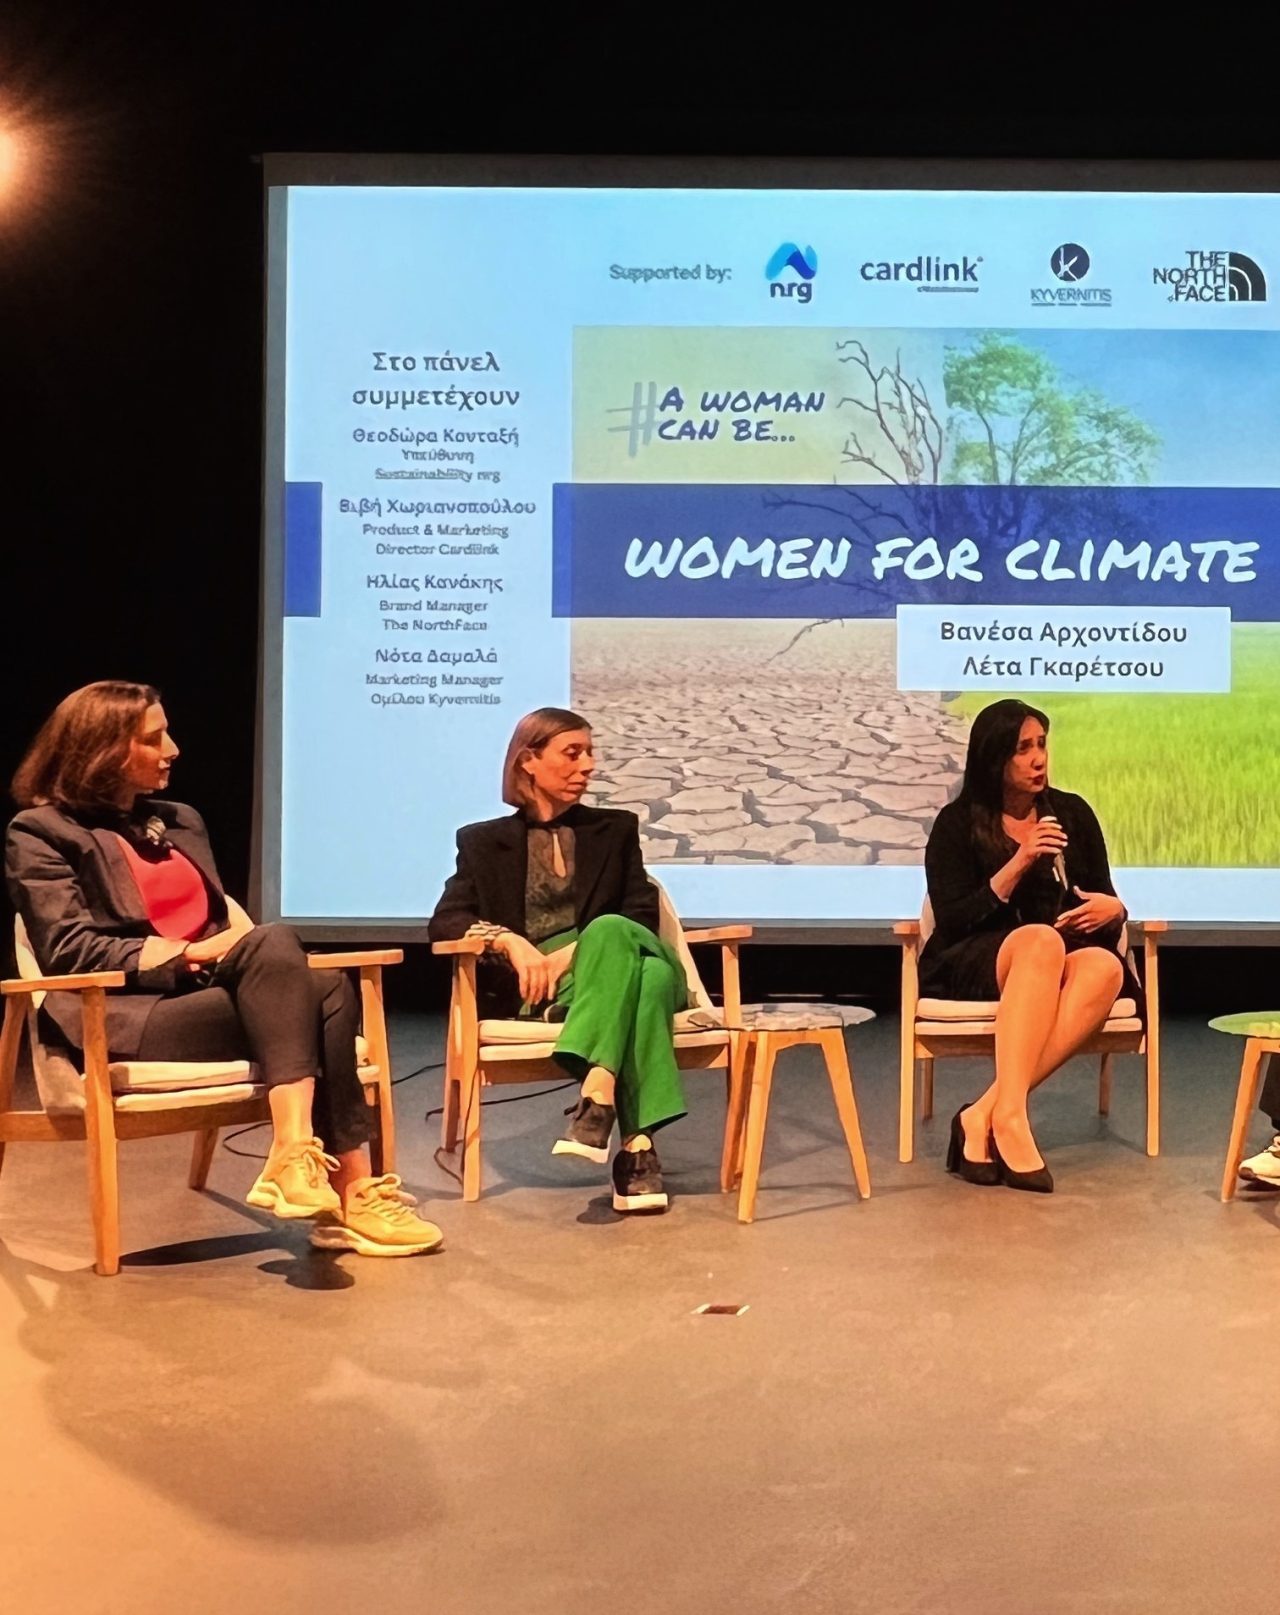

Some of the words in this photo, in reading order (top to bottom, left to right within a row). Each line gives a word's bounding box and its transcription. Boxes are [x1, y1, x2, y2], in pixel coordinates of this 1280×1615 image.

[1185, 251, 1226, 268] THE
[609, 264, 701, 283] Supported
[705, 264, 732, 284] by:
[1153, 268, 1226, 285] NORTH
[770, 282, 813, 304] nrg
[1175, 285, 1226, 301] FACE
[373, 352, 416, 371] Στο
[423, 350, 500, 371] πάνελ
[352, 384, 520, 411] συμμετέχουν
[700, 390, 825, 413] WOMAN
[352, 428, 438, 447] Θεοδώρα
[658, 418, 719, 440] CAN
[731, 419, 795, 442] BE...
[362, 523, 420, 536] Product
[424, 524, 433, 535] &
[437, 523, 509, 539] Marketing
[376, 542, 436, 555] Director
[624, 537, 851, 581] WOMEN
[872, 536, 984, 581] FOR
[1005, 538, 1260, 583] CLIMATE
[366, 573, 420, 593] Ηλίας
[379, 600, 422, 612] Brand
[940, 620, 1033, 642] Βανέσα
[1039, 622, 1187, 647] Αρχοντίδου
[375, 648, 422, 664] Νότα
[963, 655, 1022, 676] Λέτα
[1030, 655, 1164, 682] Γκαρέτσου
